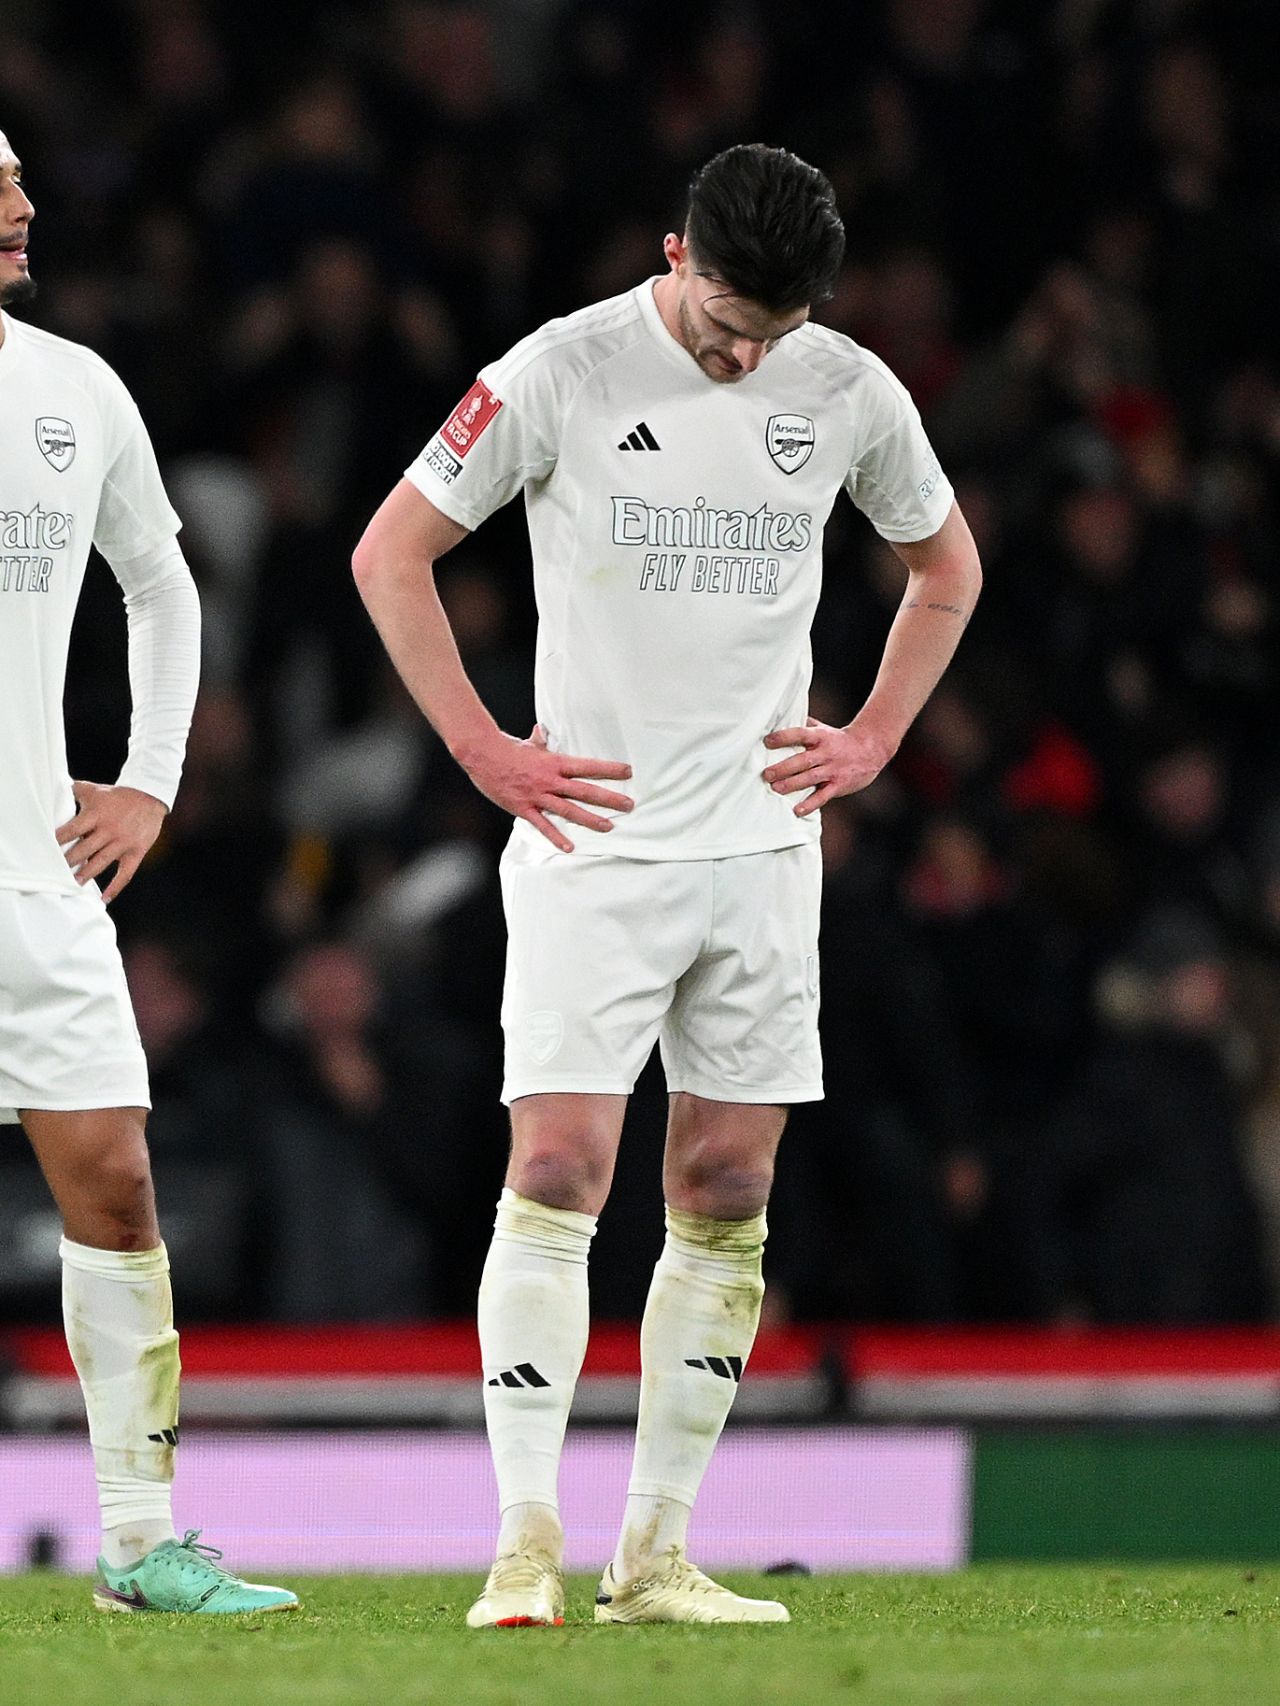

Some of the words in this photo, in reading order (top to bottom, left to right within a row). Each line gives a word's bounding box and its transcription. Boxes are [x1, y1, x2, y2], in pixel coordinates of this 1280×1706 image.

[42, 425, 70, 436] Arsenal
[774, 424, 809, 434] Arsenal
[611, 496, 812, 551] Emirates
[639, 553, 686, 591] FLY
[691, 555, 780, 595] BETTER
